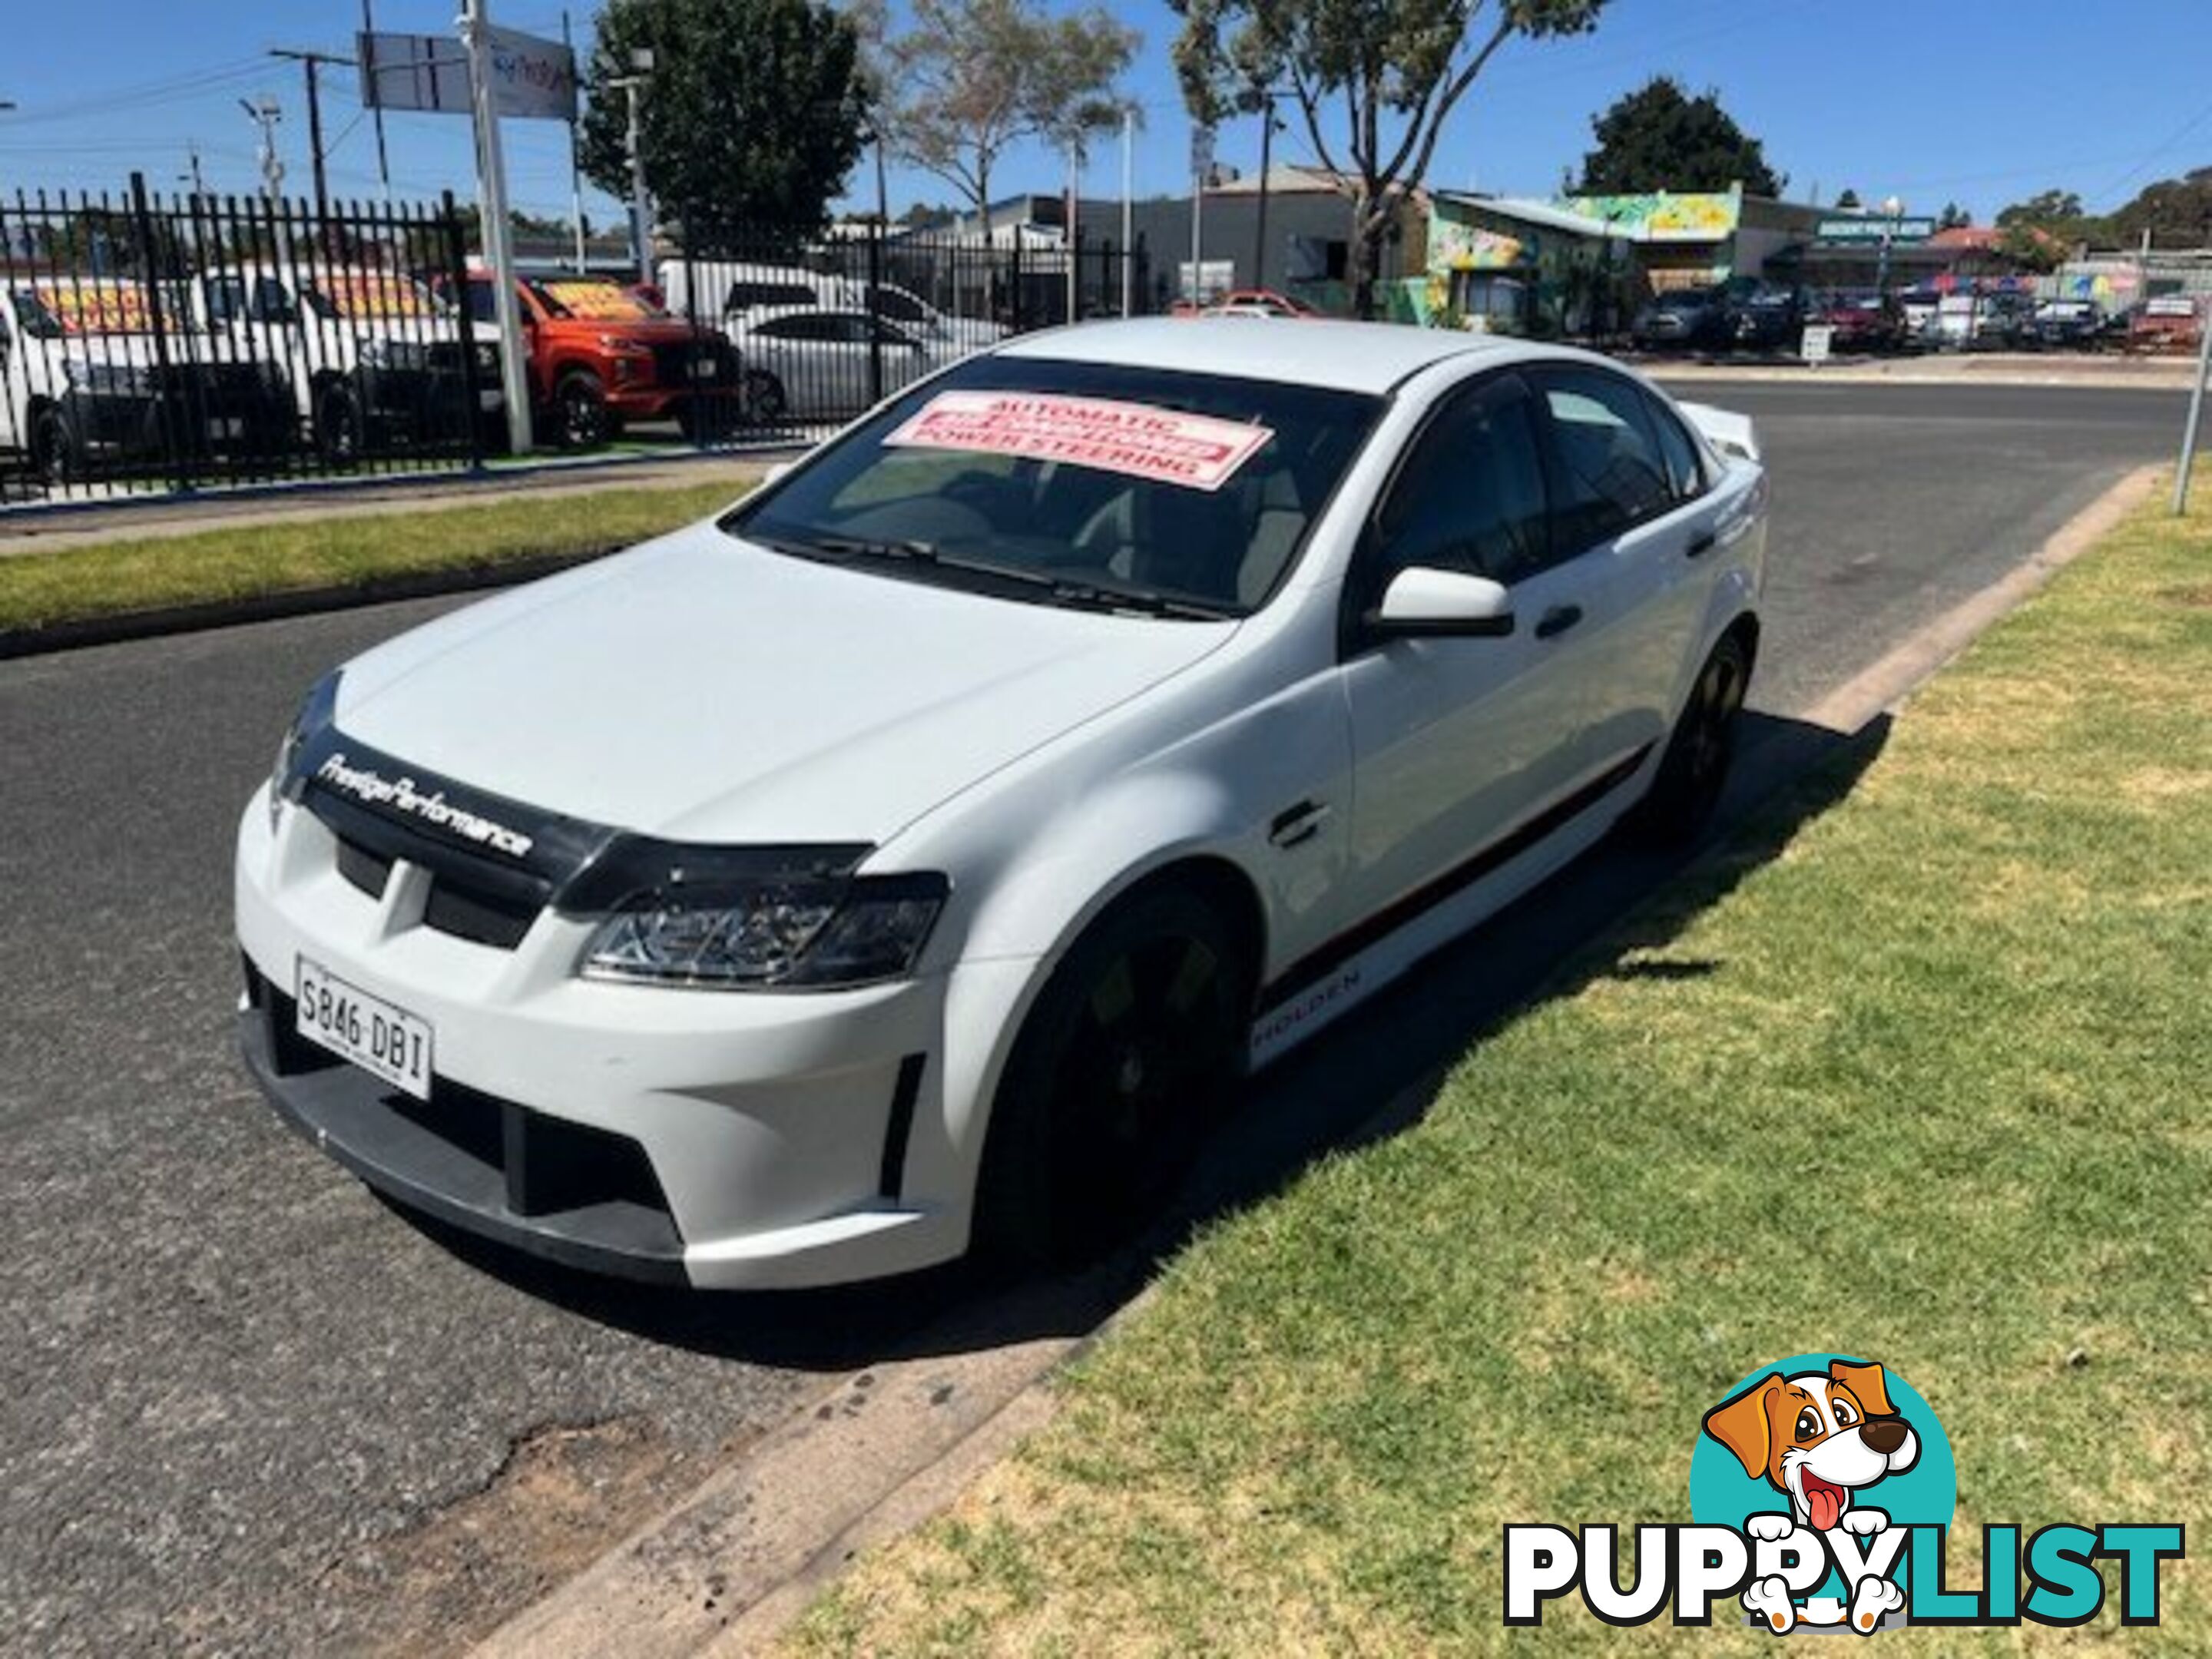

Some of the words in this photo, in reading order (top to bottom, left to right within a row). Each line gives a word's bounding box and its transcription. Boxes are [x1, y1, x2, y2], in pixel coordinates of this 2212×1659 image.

[991, 399, 1181, 432] AUTOMATIC
[912, 427, 1020, 448] POWER
[1028, 438, 1200, 476] STEERING
[1254, 969, 1360, 1048] HOLDEN
